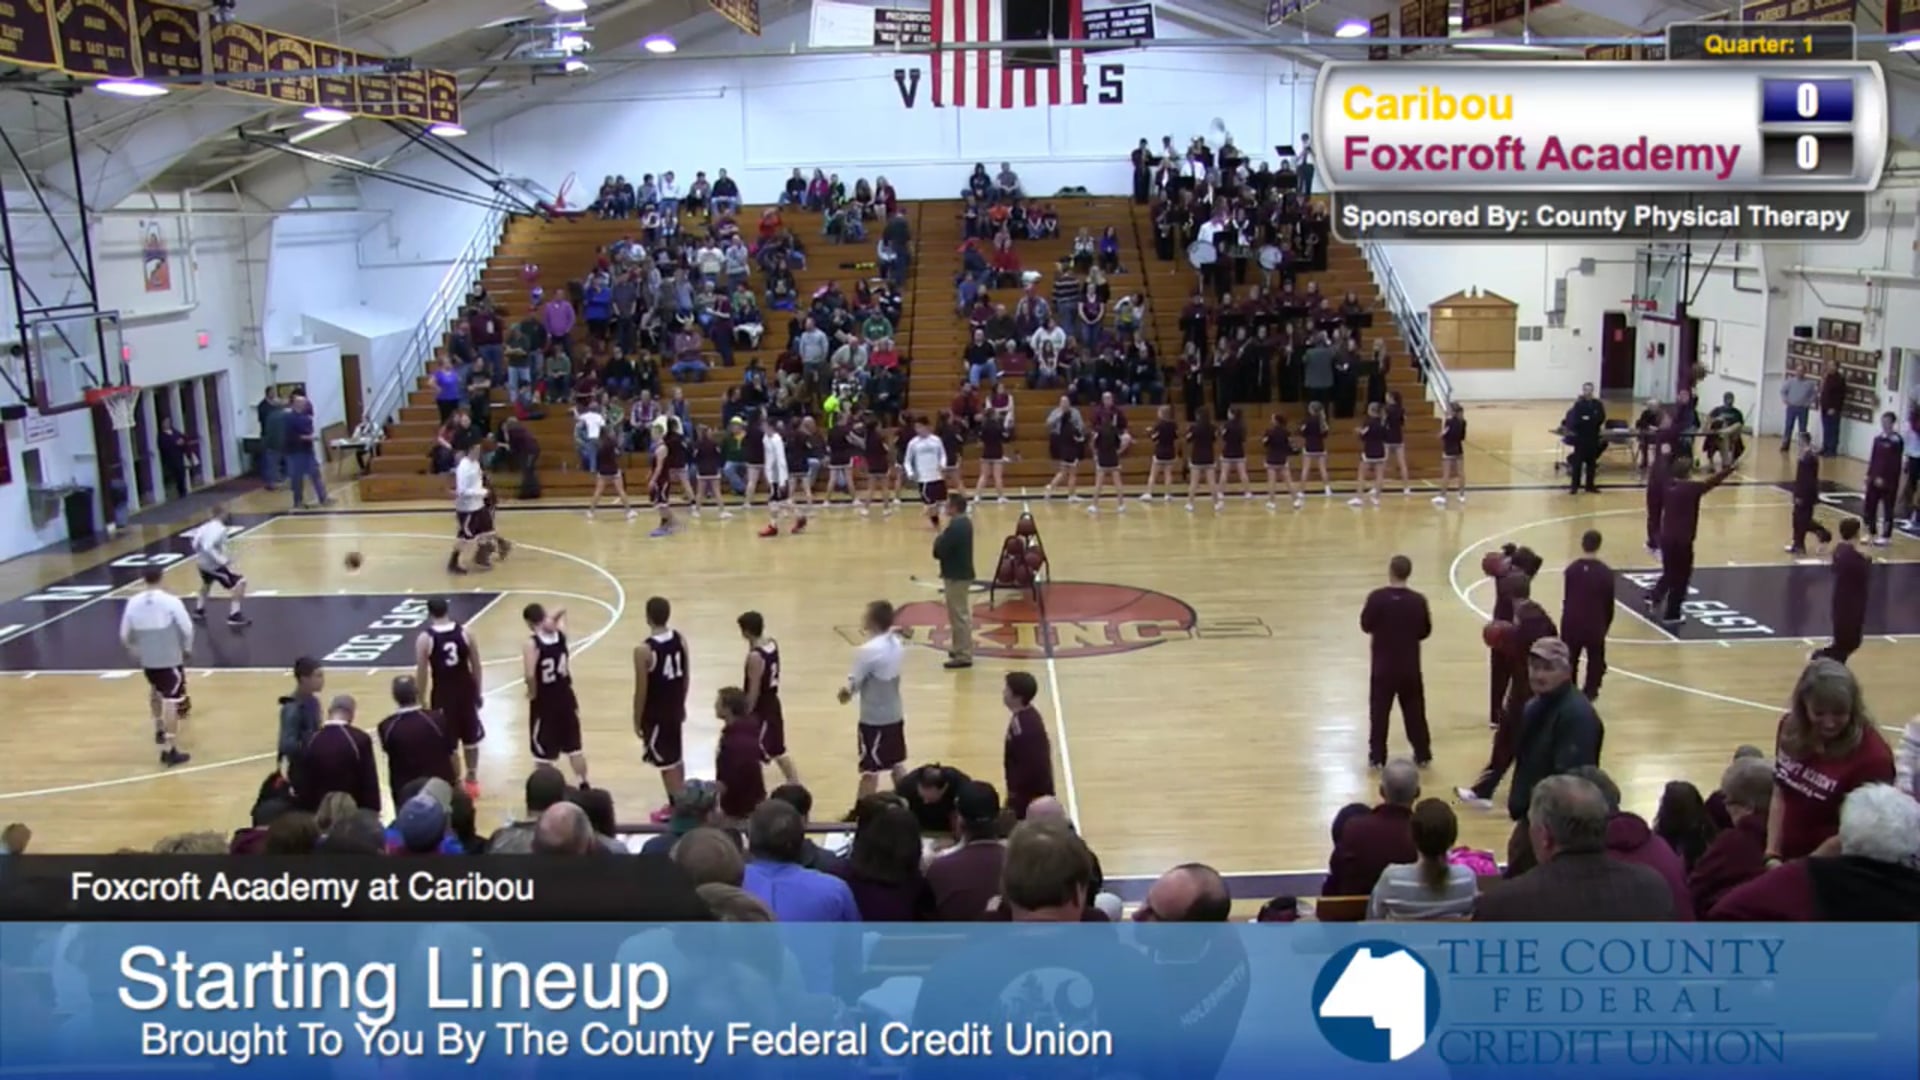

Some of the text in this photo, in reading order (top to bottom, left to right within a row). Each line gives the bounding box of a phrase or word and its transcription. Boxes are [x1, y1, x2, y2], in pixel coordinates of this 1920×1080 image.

[443, 641, 460, 667] 3
[541, 652, 568, 684] 24
[663, 651, 684, 680] 41
